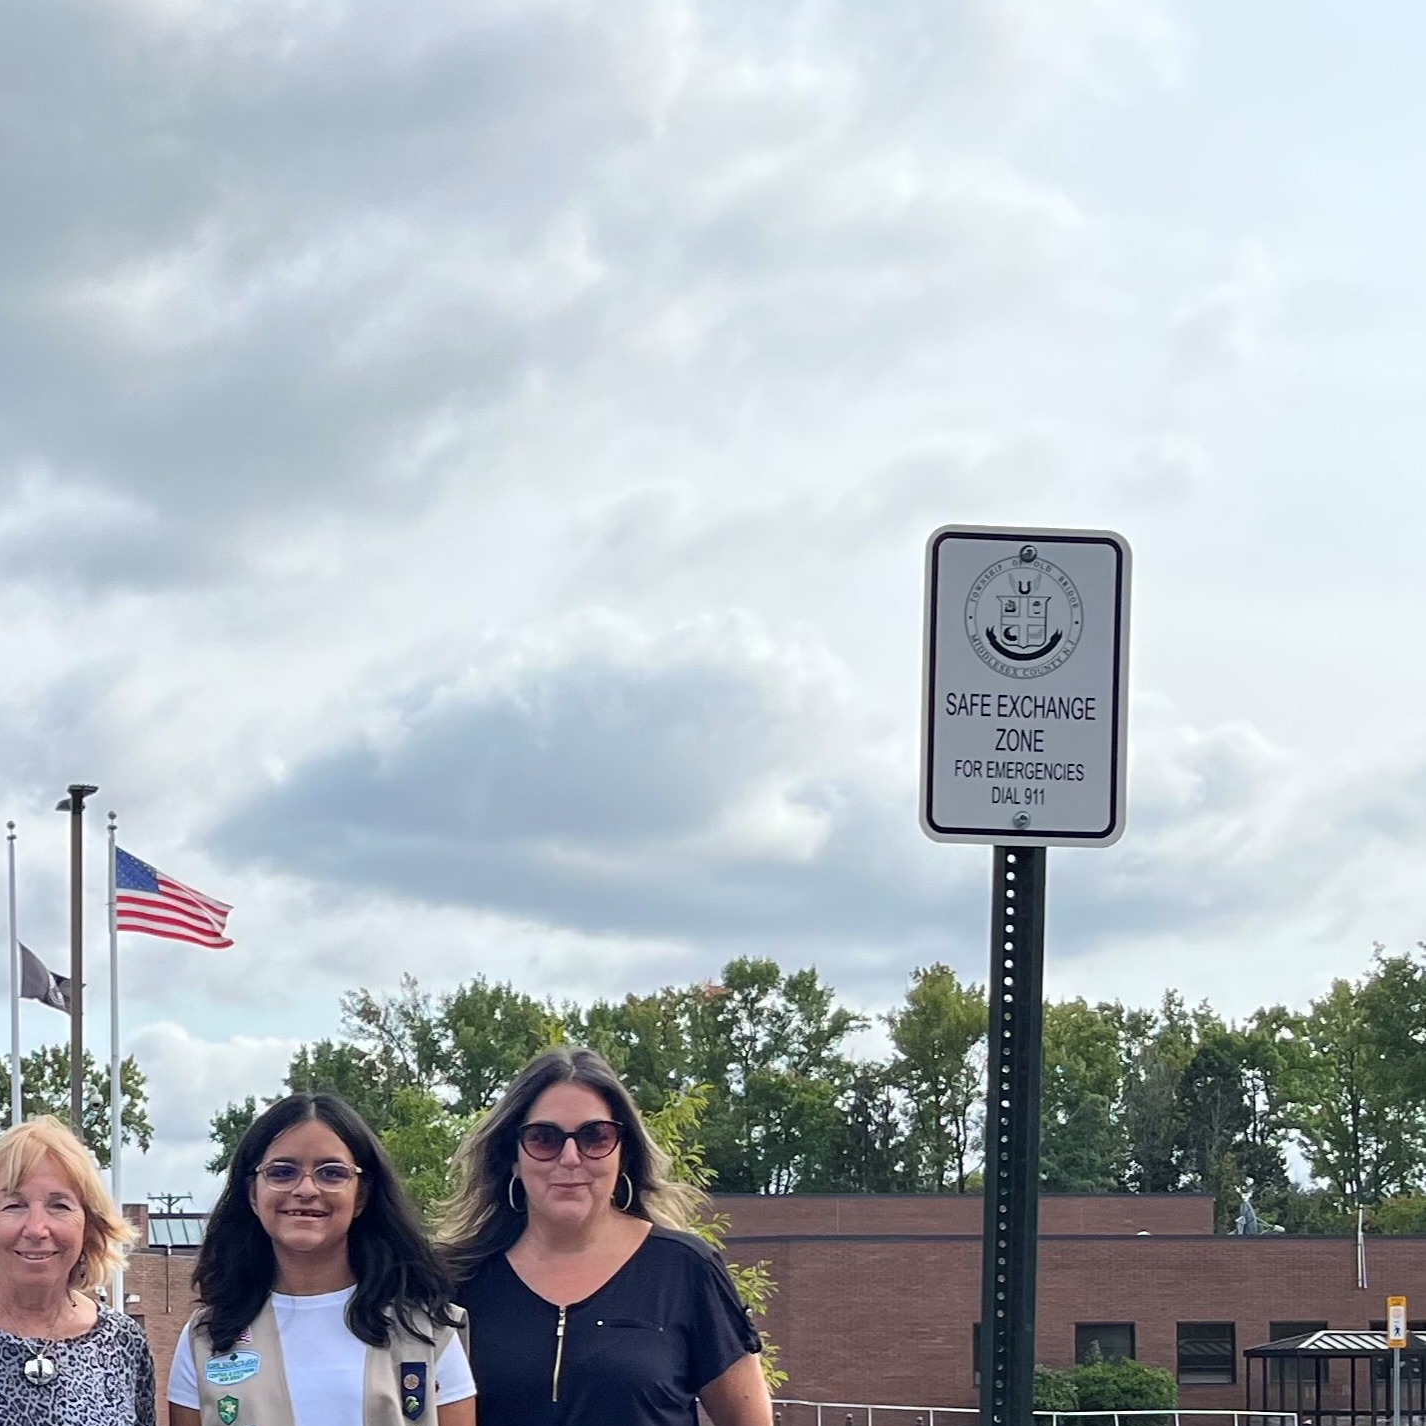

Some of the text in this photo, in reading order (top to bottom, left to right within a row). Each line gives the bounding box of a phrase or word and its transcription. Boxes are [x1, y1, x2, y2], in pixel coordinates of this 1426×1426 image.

[969, 563, 1003, 602] TOWNSHIP
[1033, 560, 1053, 573] OLD
[1057, 575, 1079, 609] BRIDGE
[970, 633, 1018, 676] MIDDLESEX
[1022, 654, 1064, 677] COUNTY
[945, 692, 1096, 721] SAFE EXCHANGE
[994, 728, 1045, 753] ZONE
[954, 759, 1085, 781] FOR EMERGENCIES
[991, 786, 1045, 805] DIAL 911
